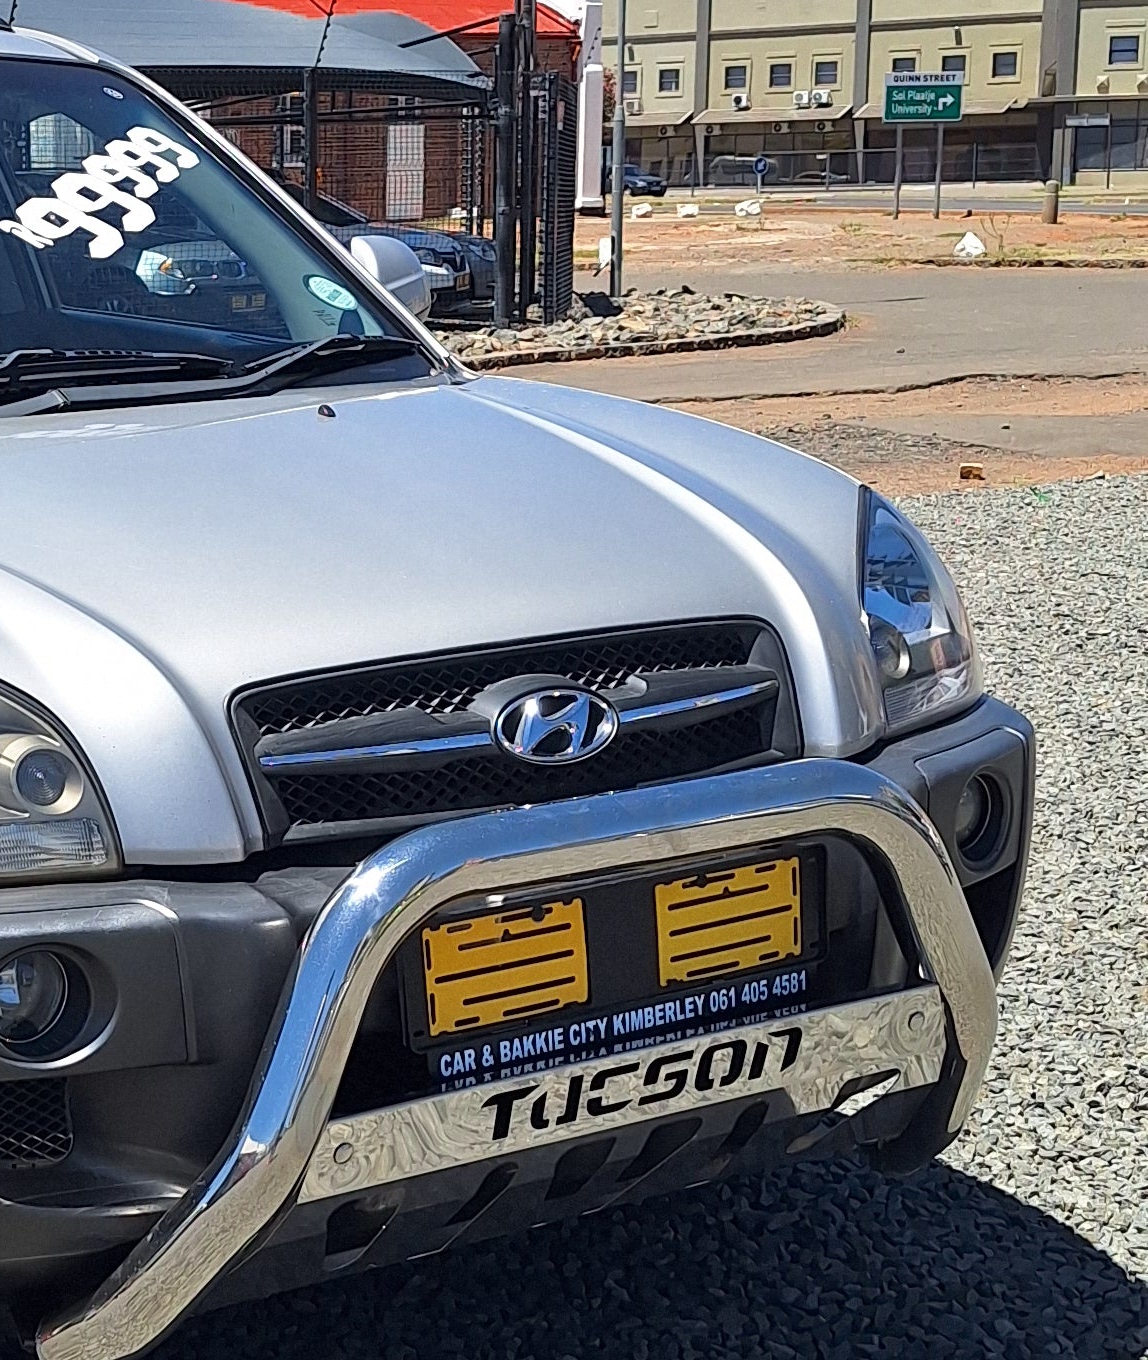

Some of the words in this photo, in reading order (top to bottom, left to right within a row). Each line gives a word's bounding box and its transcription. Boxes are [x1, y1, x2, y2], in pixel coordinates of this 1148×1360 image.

[893, 74, 921, 83] QUINN
[923, 74, 957, 82] STREET
[891, 103, 933, 116] University
[440, 1048, 477, 1078] CAR
[482, 1044, 495, 1068] &
[499, 1027, 565, 1064] BAKKIE
[569, 1016, 608, 1046] CITY
[612, 993, 706, 1037] KIMBERLEY
[709, 986, 736, 1013] 061
[741, 979, 768, 1005] 405
[772, 969, 807, 997] 4581
